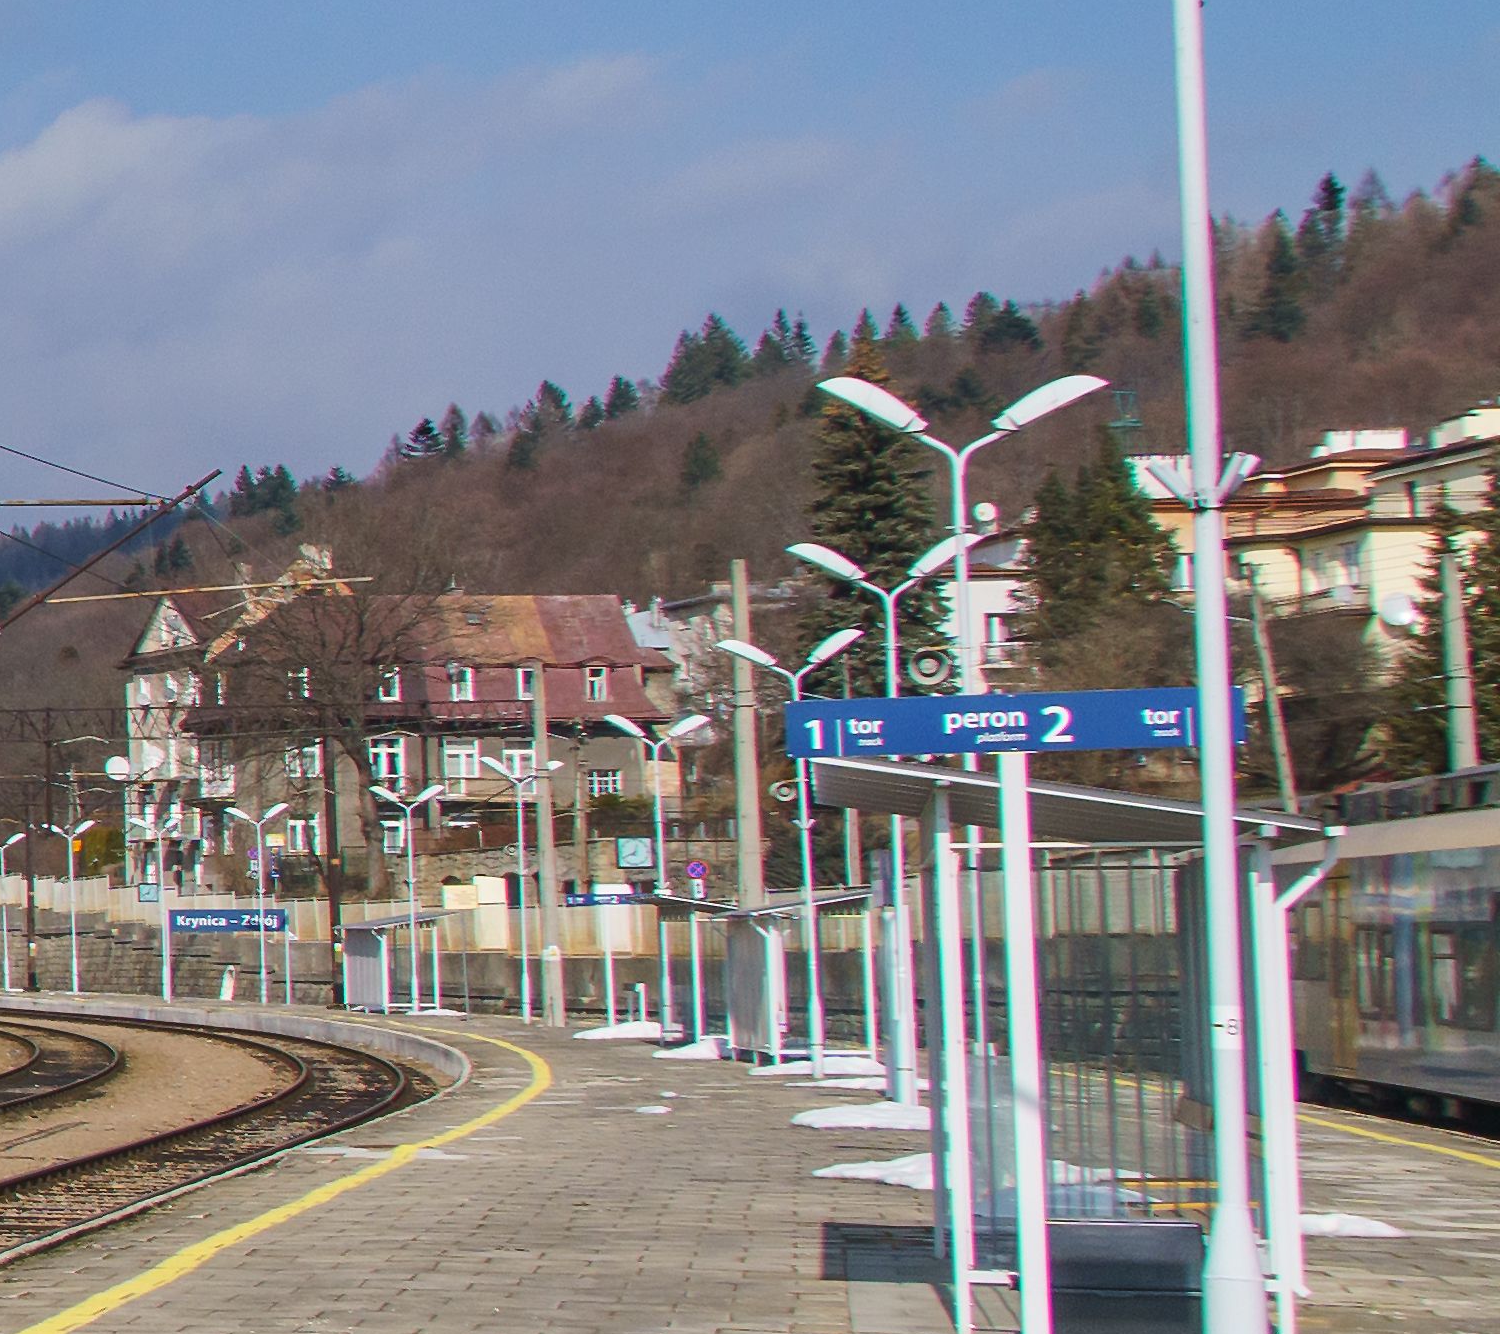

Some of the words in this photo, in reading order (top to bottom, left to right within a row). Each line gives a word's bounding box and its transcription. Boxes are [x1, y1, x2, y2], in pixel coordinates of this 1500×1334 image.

[943, 710, 1028, 734] peron
[1040, 705, 1075, 743] 2
[1141, 709, 1182, 725] tor
[804, 719, 824, 750] 1
[847, 717, 884, 734] tor
[176, 915, 226, 929] Krynica
